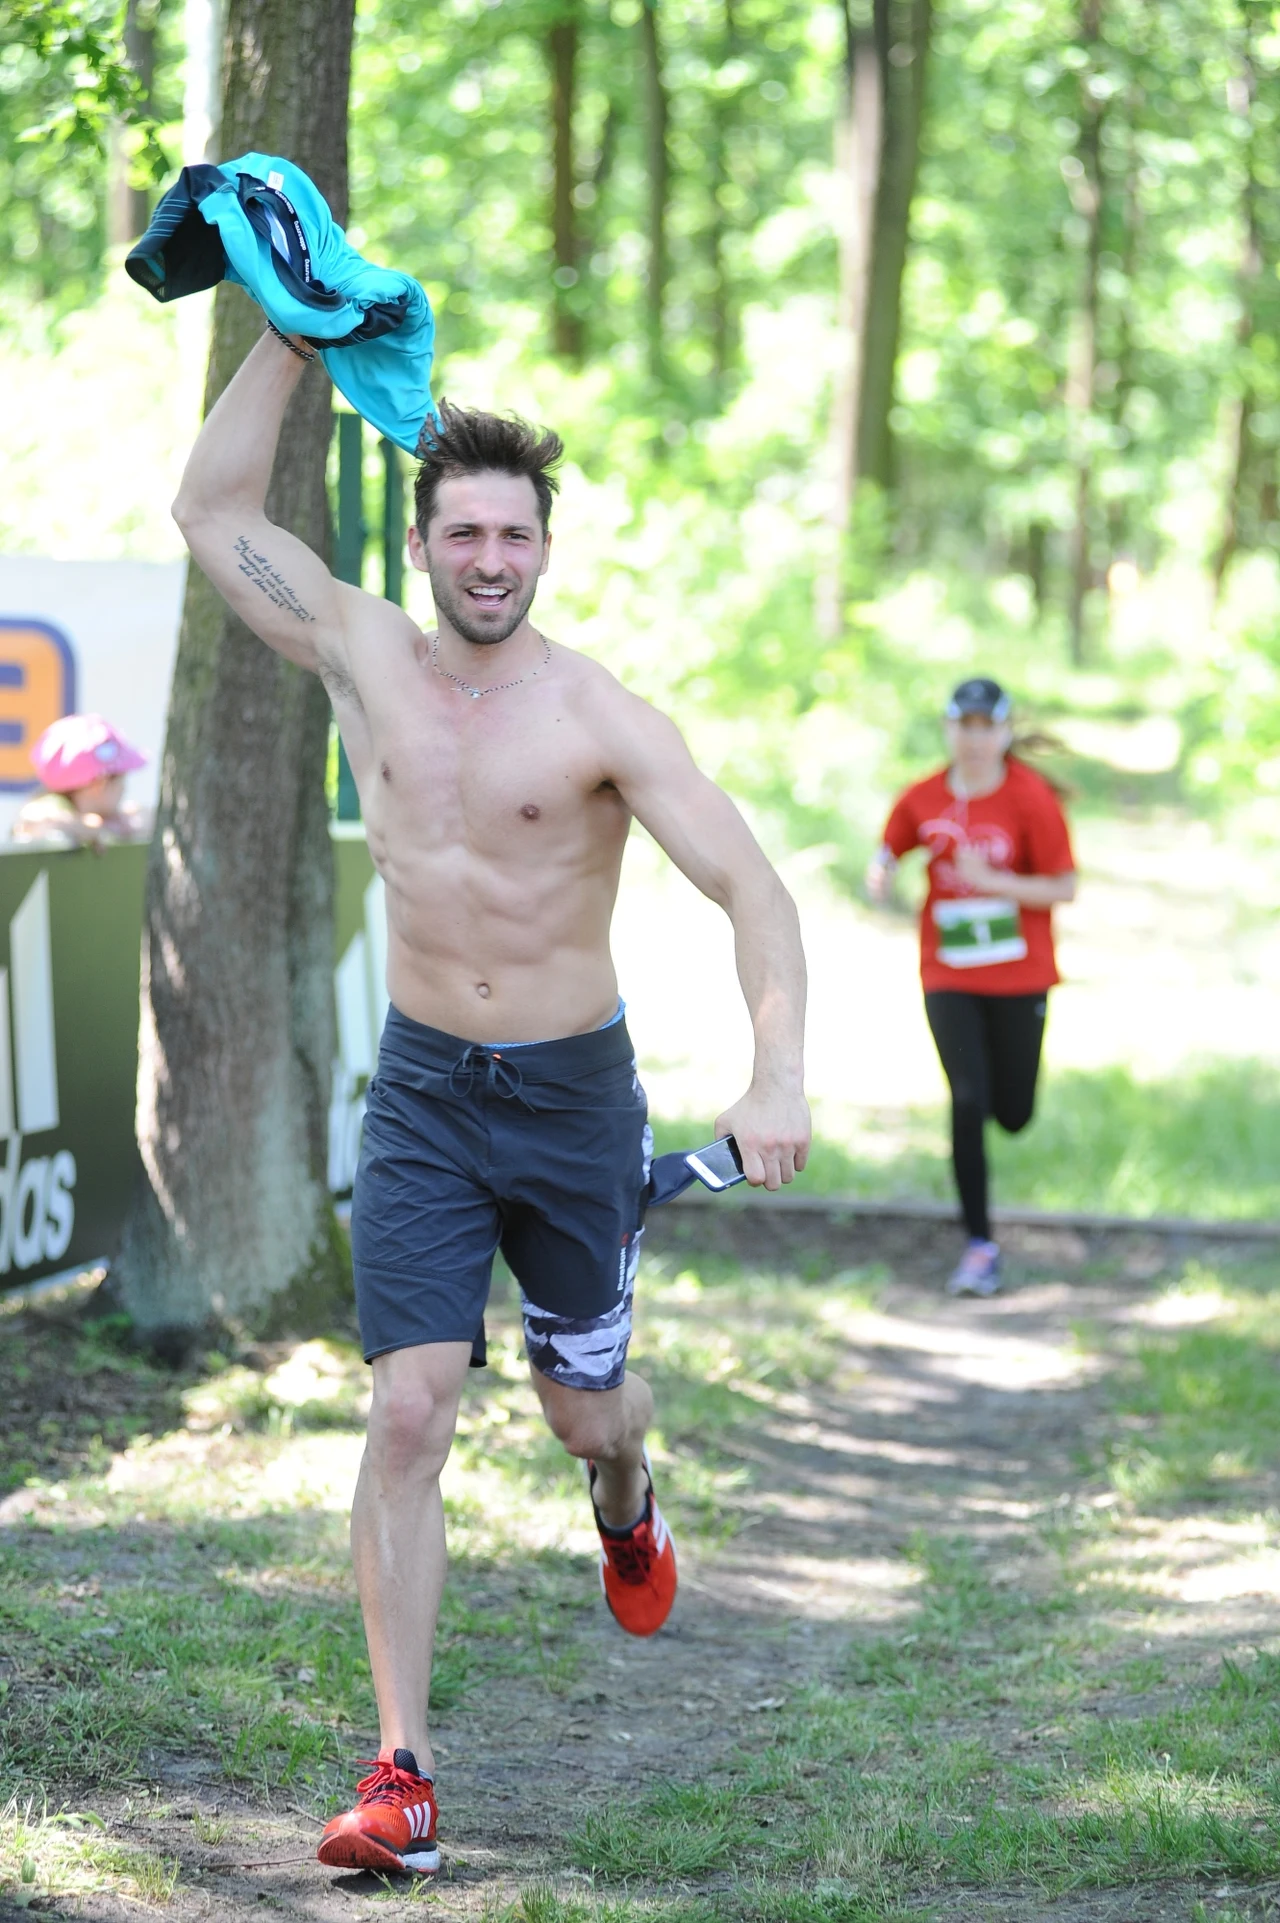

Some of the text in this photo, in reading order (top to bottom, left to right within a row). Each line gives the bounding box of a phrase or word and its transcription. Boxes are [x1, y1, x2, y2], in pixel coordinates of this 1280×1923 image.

[238, 564, 285, 608] what others can't
[253, 553, 268, 564] will
[270, 572, 286, 585] what
[283, 586, 299, 603] others
[265, 579, 276, 589] can
[617, 1247, 626, 1291] Reebok
